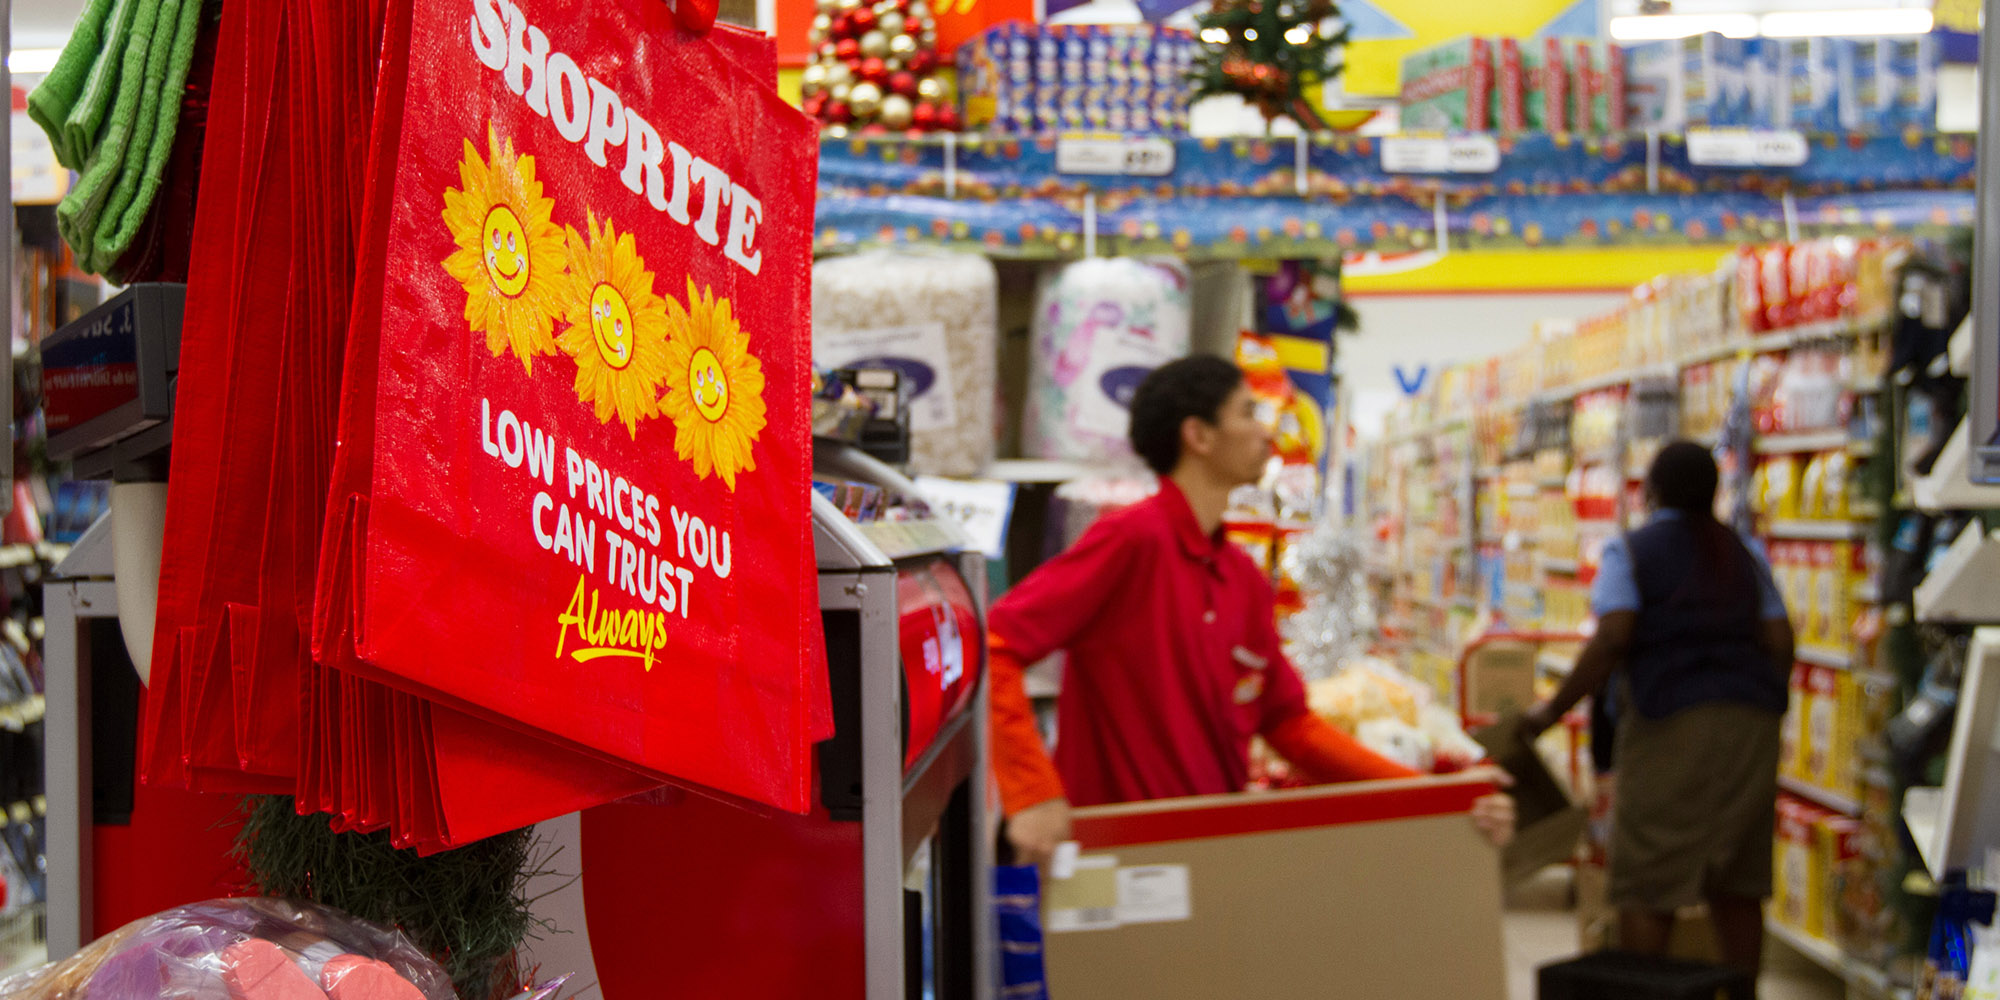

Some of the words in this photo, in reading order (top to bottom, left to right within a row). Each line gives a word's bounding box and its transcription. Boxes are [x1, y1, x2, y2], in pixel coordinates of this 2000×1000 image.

[471, 0, 763, 275] SHOPRITE
[482, 397, 555, 486] LOW
[566, 446, 661, 547] PRICES
[671, 505, 731, 578] YOU
[532, 491, 595, 574] CAN
[606, 530, 694, 619] TRUST
[555, 573, 667, 672] Always
